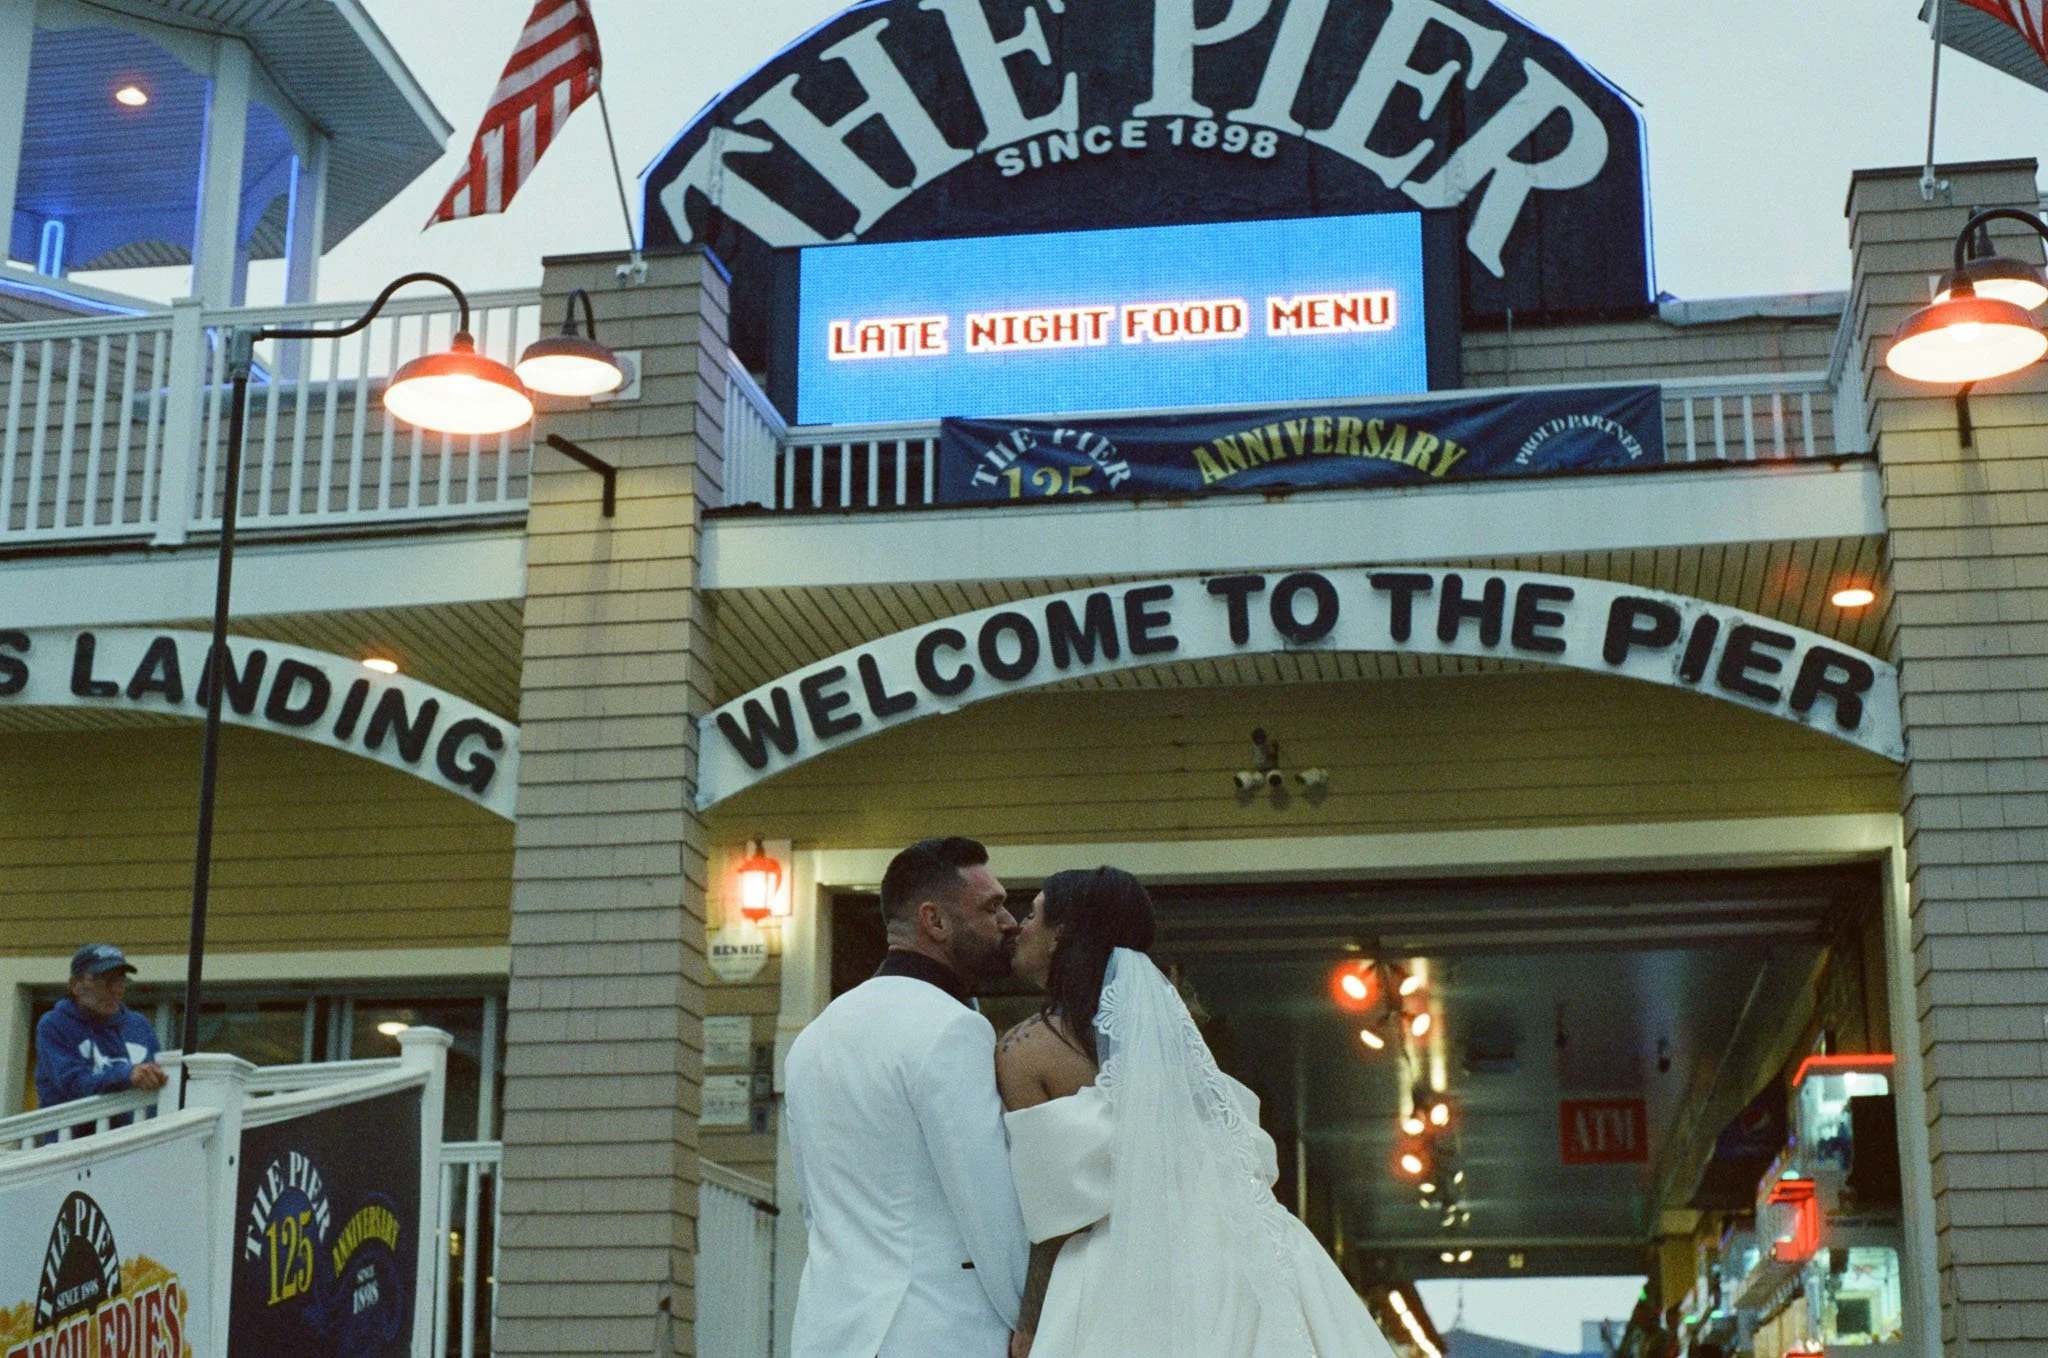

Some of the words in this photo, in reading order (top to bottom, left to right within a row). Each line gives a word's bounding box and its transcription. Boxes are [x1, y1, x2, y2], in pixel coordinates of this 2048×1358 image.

[660, 0, 1079, 248] THE
[1133, 0, 1608, 278] PIER
[994, 120, 1148, 177] SINCE
[1166, 118, 1278, 159] 1898
[831, 318, 945, 357] LATE
[968, 308, 1112, 349] NIGHT
[1124, 301, 1245, 340] FOOD
[1270, 293, 1393, 334] MENU
[971, 428, 1038, 490] THE
[1053, 428, 1132, 490] PIER
[1001, 466, 1096, 498] 125
[1193, 415, 1467, 485] ANNIVERSARY
[716, 584, 1179, 770] WELCOME
[1207, 572, 1340, 645] TO
[1370, 573, 1575, 652] THE
[1602, 595, 1874, 730] PIER
[71, 631, 504, 793] LANDING
[1572, 1108, 1636, 1153] ATM
[244, 1160, 284, 1261] THE
[289, 1151, 331, 1245] PIER
[266, 1209, 314, 1306] 125
